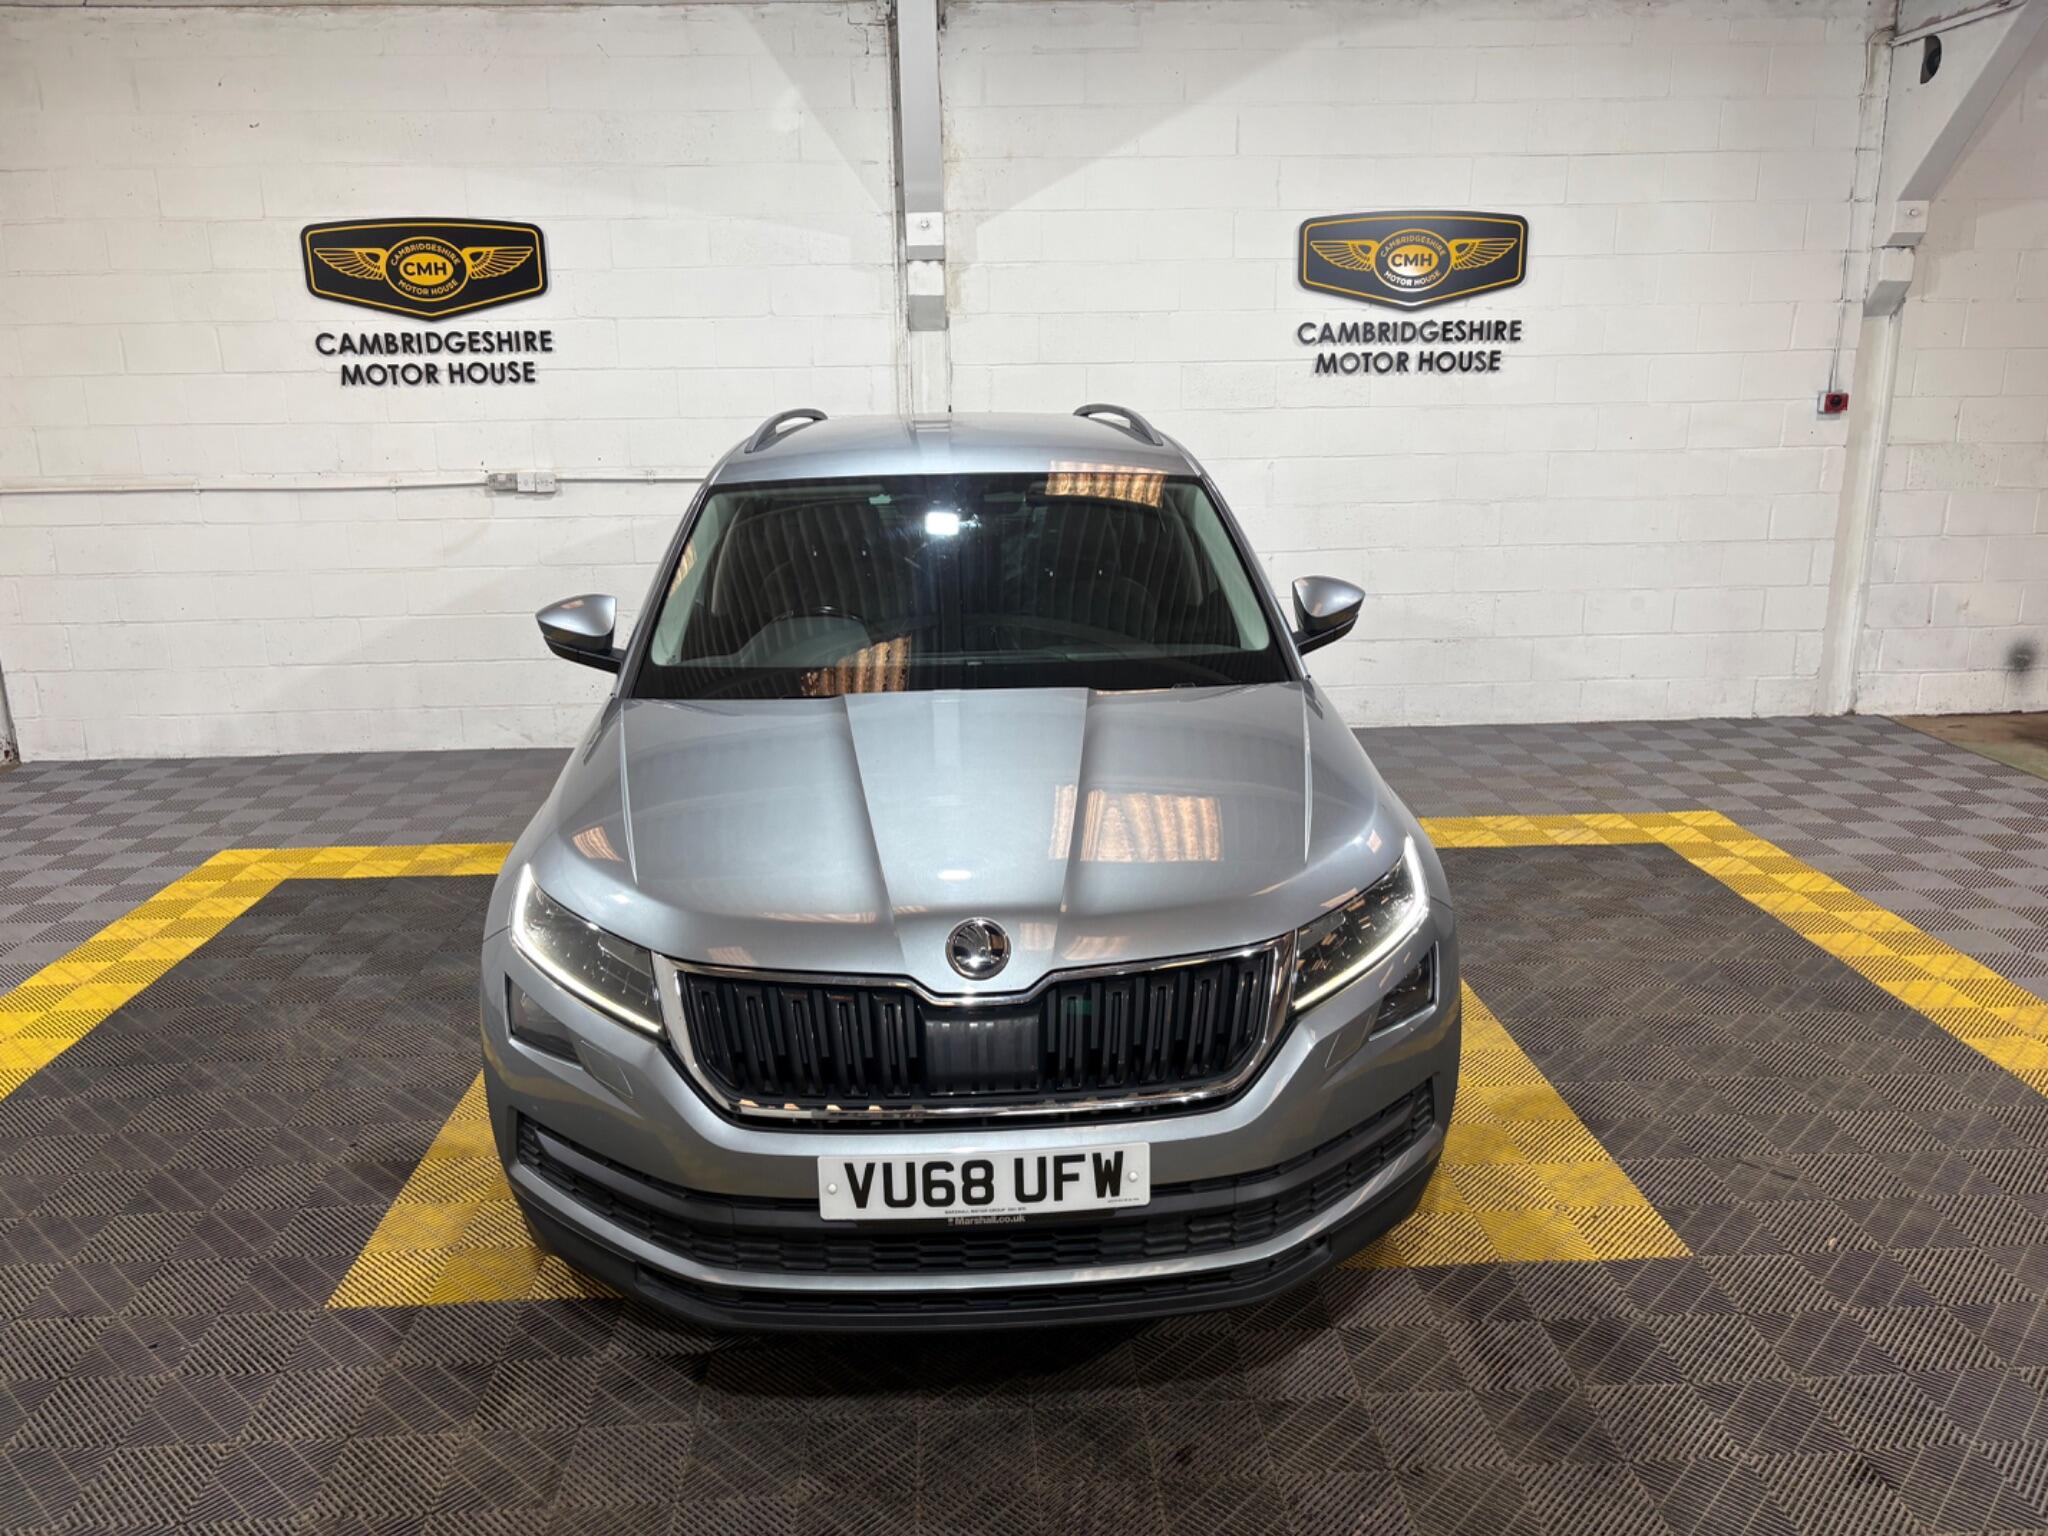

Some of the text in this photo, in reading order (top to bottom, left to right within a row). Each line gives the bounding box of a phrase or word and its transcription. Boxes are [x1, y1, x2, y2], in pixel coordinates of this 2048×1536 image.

[391, 243, 460, 266] CAMBRIDGESHIRE
[1381, 235, 1446, 257] CAMBRIDGESHIRE
[403, 262, 447, 276] CMH
[1391, 253, 1433, 267] CMH
[398, 278, 458, 295] MOTOR HOUSE
[1384, 270, 1441, 286] MOTOR HOUSE
[315, 331, 553, 355] CAMBRIDGESHIRE
[1297, 320, 1522, 345] CAMBRIDGESHIRE
[341, 361, 536, 386] MOTOR HOUSE
[1315, 350, 1502, 374] MOTOR HOUSE
[844, 1151, 1123, 1209] VU68 UFW
